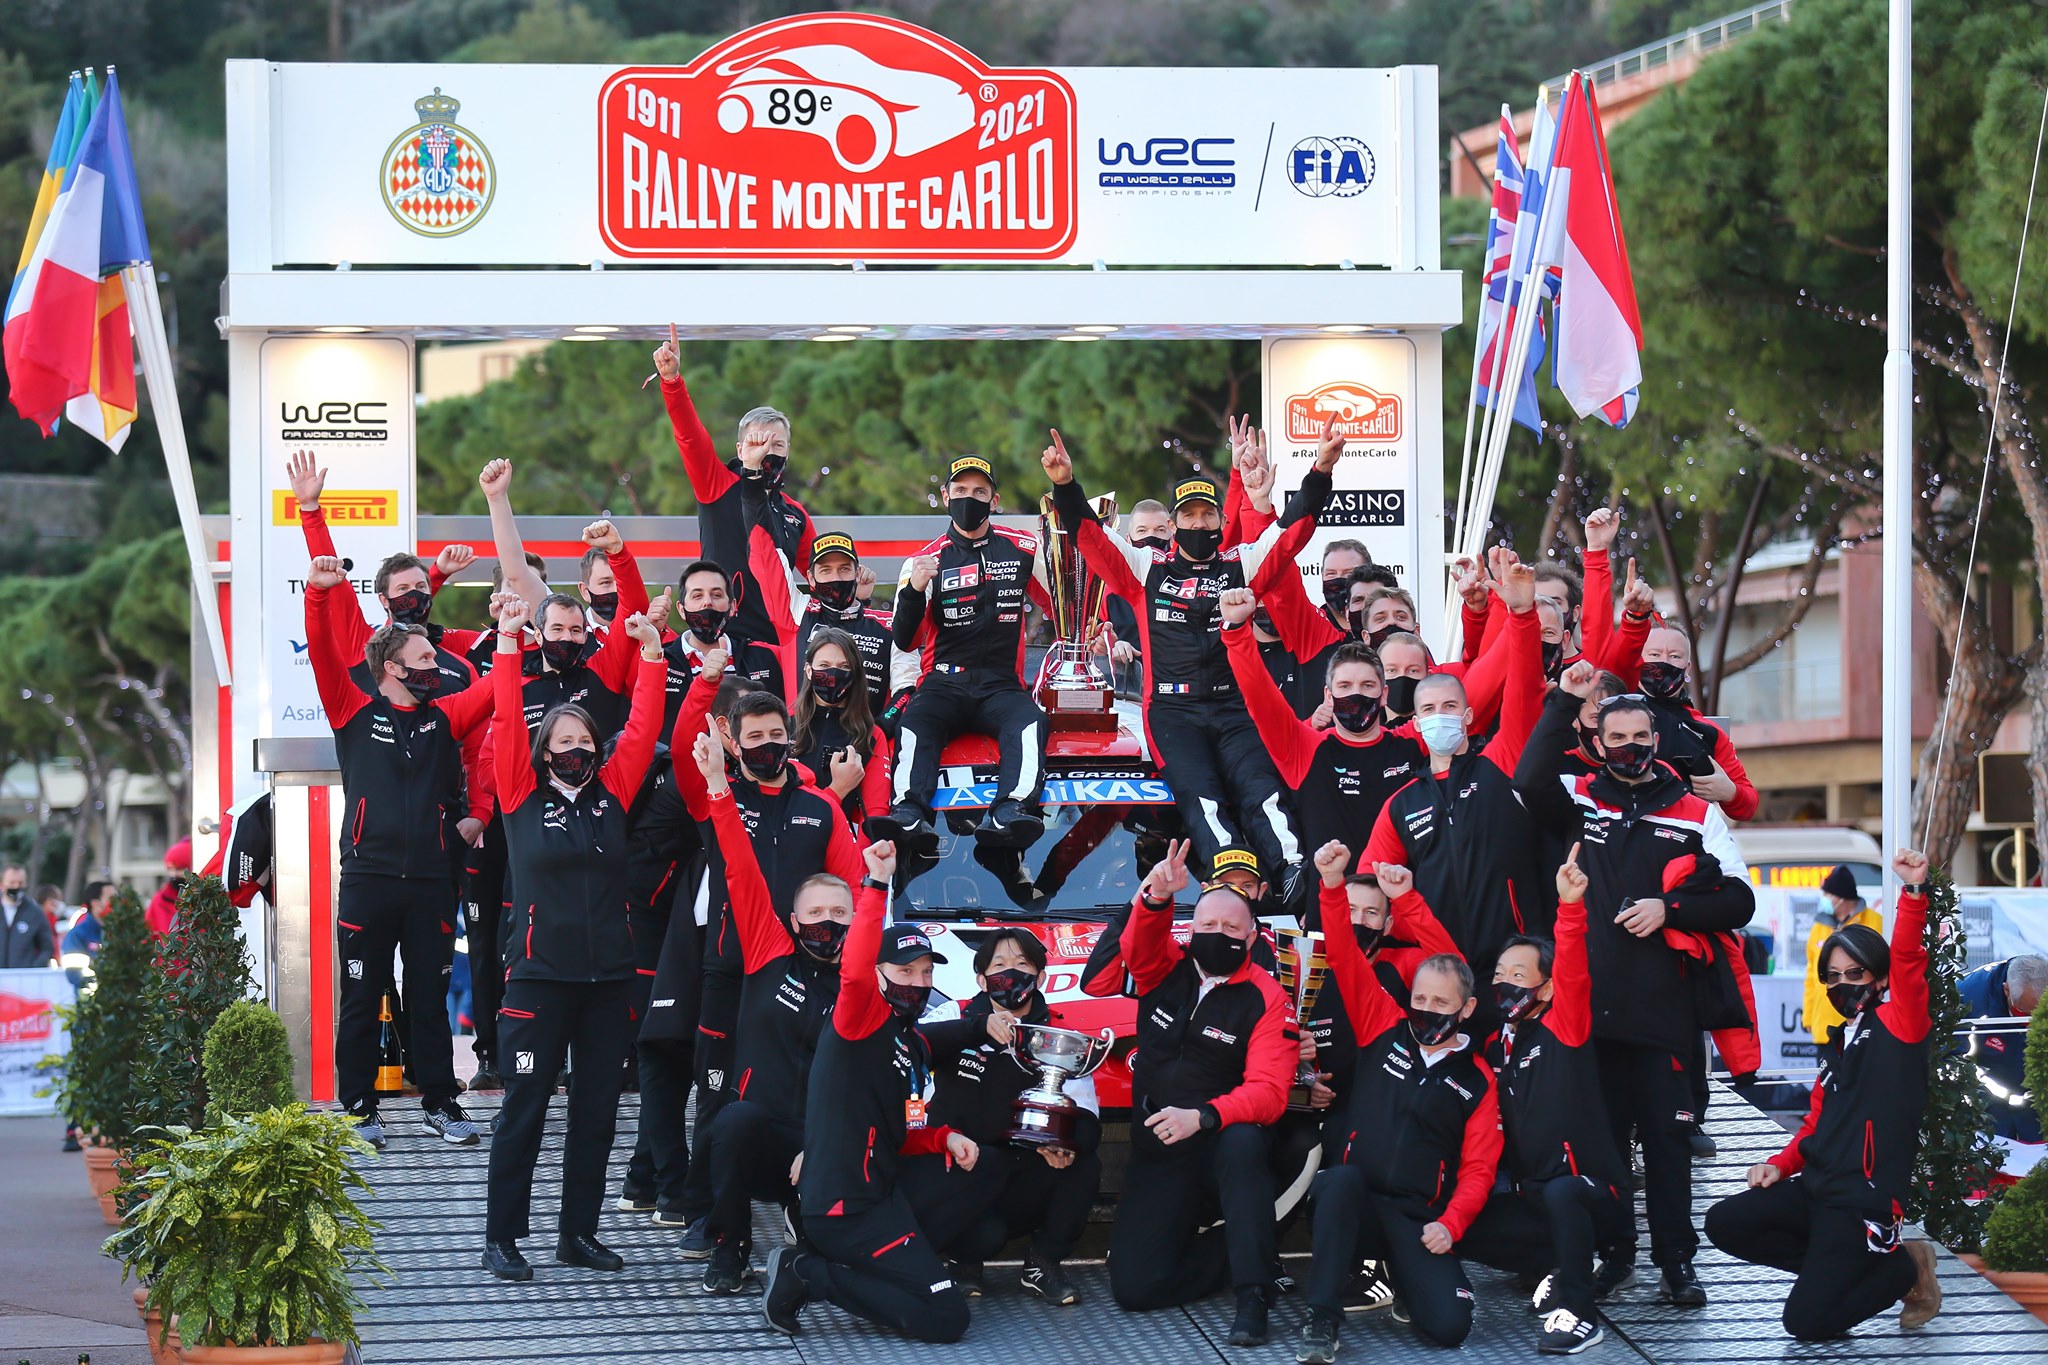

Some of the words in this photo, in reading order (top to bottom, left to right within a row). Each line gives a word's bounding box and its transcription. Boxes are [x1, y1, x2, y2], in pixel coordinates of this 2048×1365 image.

[625, 83, 682, 139] 1911
[977, 88, 1047, 151] 2021
[1099, 138, 1235, 166] WRC
[623, 132, 757, 230] RALLYE
[772, 137, 1054, 230] MONTE-CARLO
[1102, 176, 1124, 184] FIA
[1127, 176, 1179, 184] WORLD
[1182, 176, 1232, 184] RALLY
[282, 402, 387, 423] WRC
[1292, 403, 1307, 416] 1911
[1377, 403, 1394, 417] 2021
[1292, 411, 1324, 435] RALLYE
[304, 431, 343, 439] WORLD
[346, 431, 386, 439] RALLY
[1292, 449, 1397, 458] #RalonteCarlo
[954, 461, 988, 470] PIRELLI
[1177, 485, 1212, 497] PIRELLI
[285, 497, 387, 519] PRELLI
[1323, 493, 1401, 511] ASINO
[1350, 513, 1395, 523] CARLO
[816, 536, 850, 550] PIRELLI
[1018, 539, 1036, 550] OMP
[943, 572, 978, 590] GR
[998, 589, 1023, 597] DENSO
[1160, 582, 1195, 599] GR
[863, 660, 883, 670] ENSO
[1159, 684, 1173, 692] OMP
[282, 704, 328, 721] Asah
[1068, 771, 1145, 780] GAZOO
[1408, 814, 1432, 832] DENSO
[1217, 854, 1254, 866] PIRELLI
[779, 983, 806, 1003] DENSO
[652, 999, 675, 1007] YOKO
[1387, 1052, 1412, 1070] DENSO
[930, 1280, 951, 1293] YOKO
